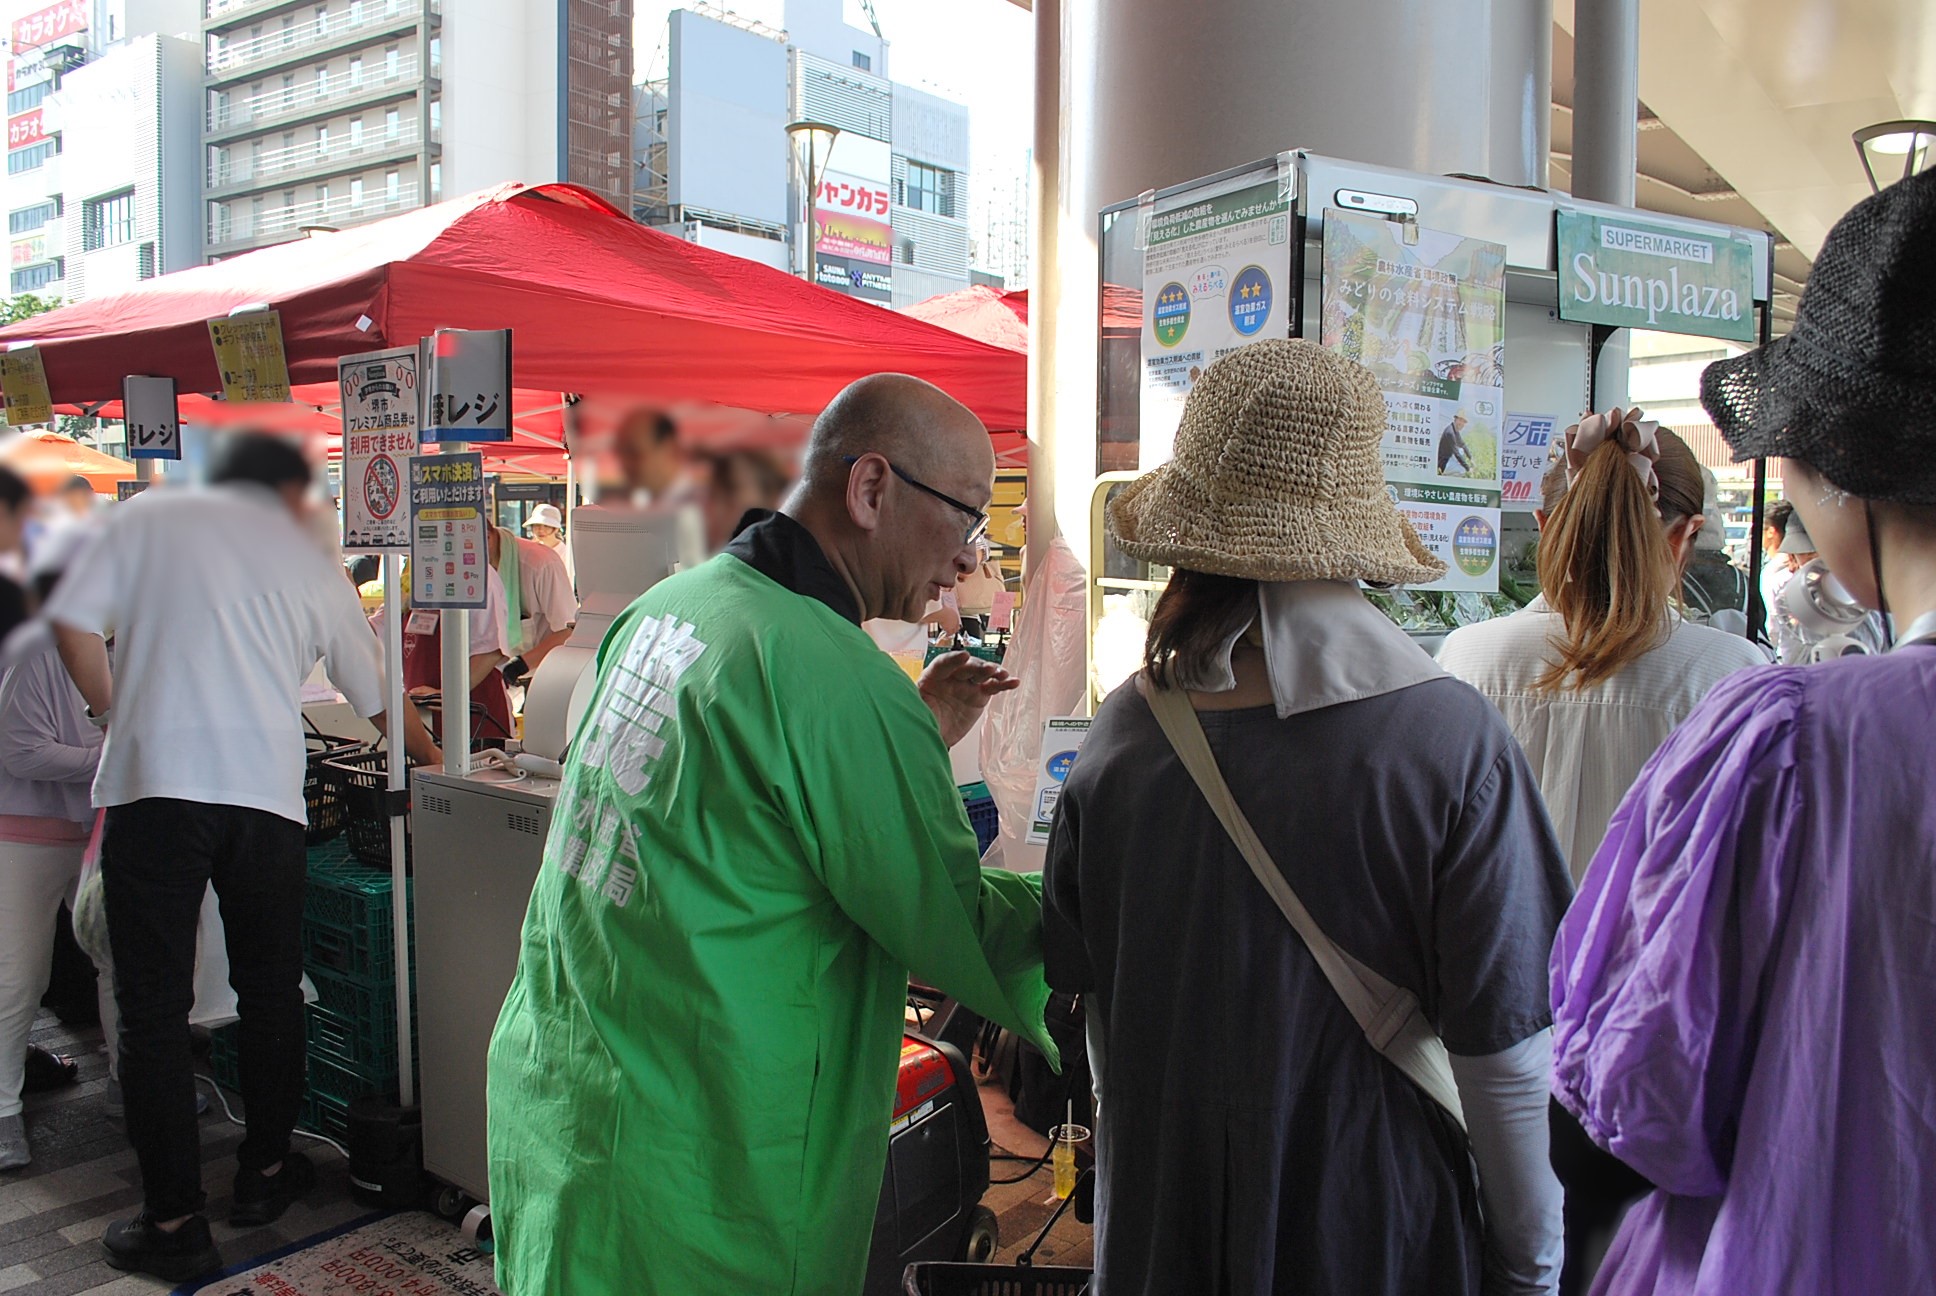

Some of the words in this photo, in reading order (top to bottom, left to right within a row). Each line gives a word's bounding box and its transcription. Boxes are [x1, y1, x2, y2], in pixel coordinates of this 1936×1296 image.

[1606, 229, 1708, 260] SUPERMARKET
[822, 263, 846, 277] SAUNA
[1376, 259, 1422, 279] 農林水産省
[862, 280, 891, 291] FITNESS
[1192, 279, 1224, 294] みえるらべる
[1572, 252, 1742, 326] Sunplaza
[1234, 300, 1267, 315] 温室効果ガス
[1244, 315, 1256, 327] 削減
[371, 398, 389, 413] 堺市
[350, 412, 415, 430] プレミアム商品券は
[350, 431, 415, 454] 利用できません
[412, 484, 484, 504] ご利用いただけます
[1403, 488, 1488, 504] 環境にやさしい農産物を販売
[1502, 481, 1532, 499] 200
